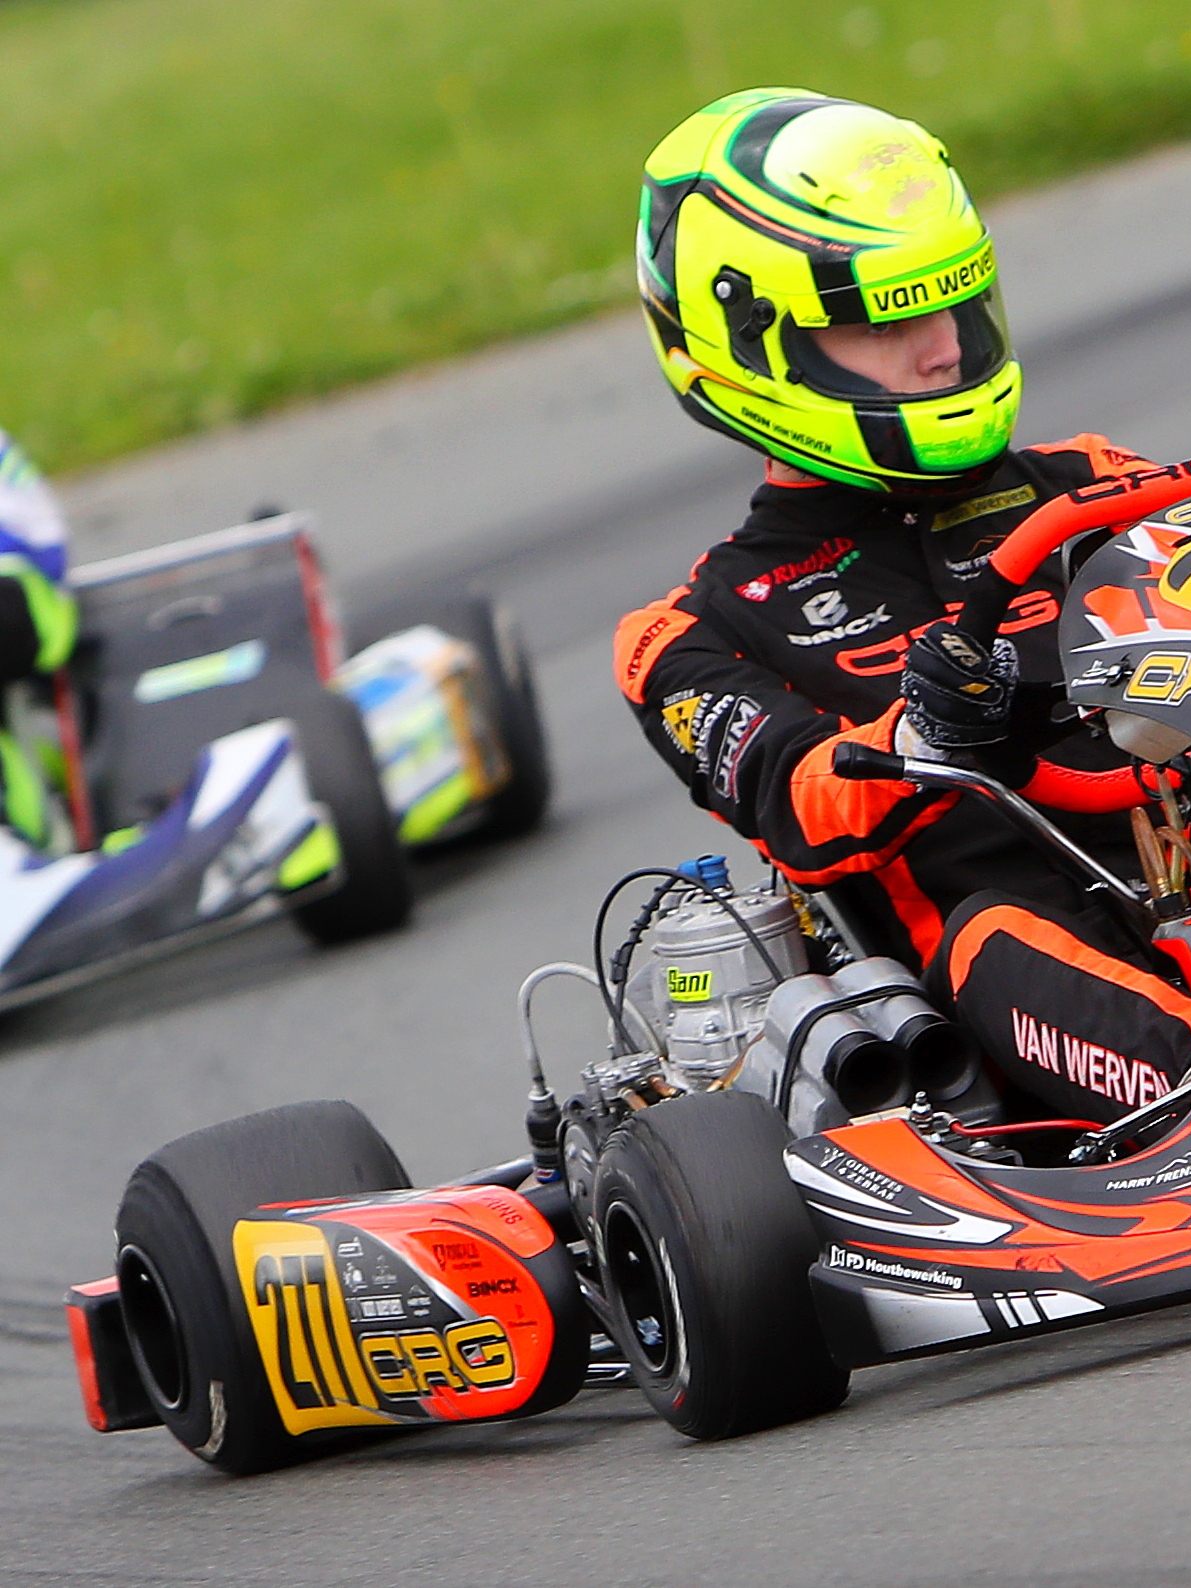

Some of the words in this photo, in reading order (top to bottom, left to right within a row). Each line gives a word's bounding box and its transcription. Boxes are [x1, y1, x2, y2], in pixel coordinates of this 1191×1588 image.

[873, 282, 929, 312] van
[935, 244, 994, 296] werve
[1011, 1007, 1061, 1075] VAN
[1062, 1032, 1172, 1108] WERVEN
[1106, 1176, 1156, 1190] HARRY
[468, 1278, 520, 1297] BINCX
[866, 1258, 962, 1289] Houtbewerking
[256, 1254, 359, 1409] 277
[359, 1316, 517, 1400] CRG
